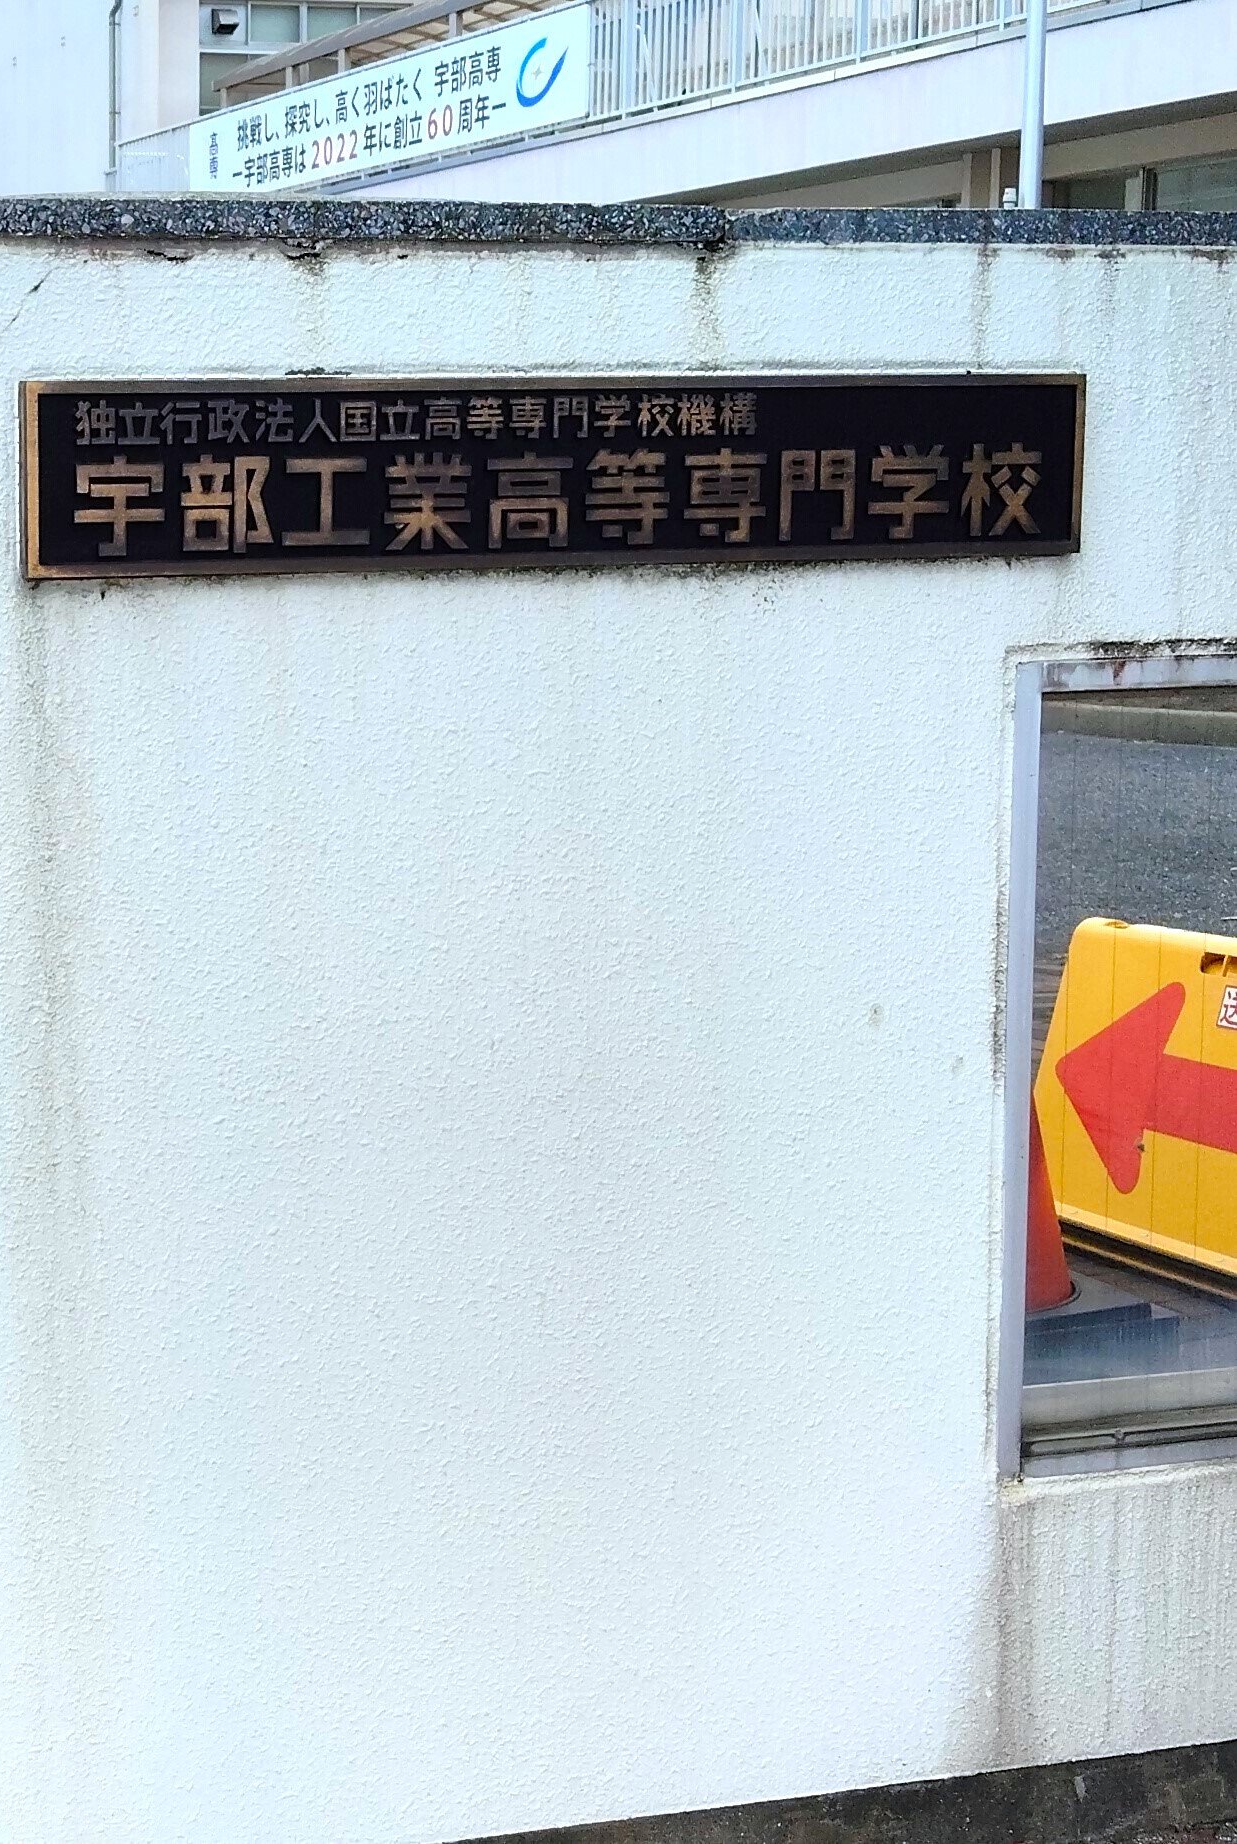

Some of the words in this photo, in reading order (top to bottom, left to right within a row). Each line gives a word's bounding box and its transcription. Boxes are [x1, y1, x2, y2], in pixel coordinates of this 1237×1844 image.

[434, 46, 502, 98] 宇部高専
[75, 393, 757, 446] 独立行政法人国立高等専門学校機構
[73, 442, 1042, 557] 宇部工業高等専門学校
